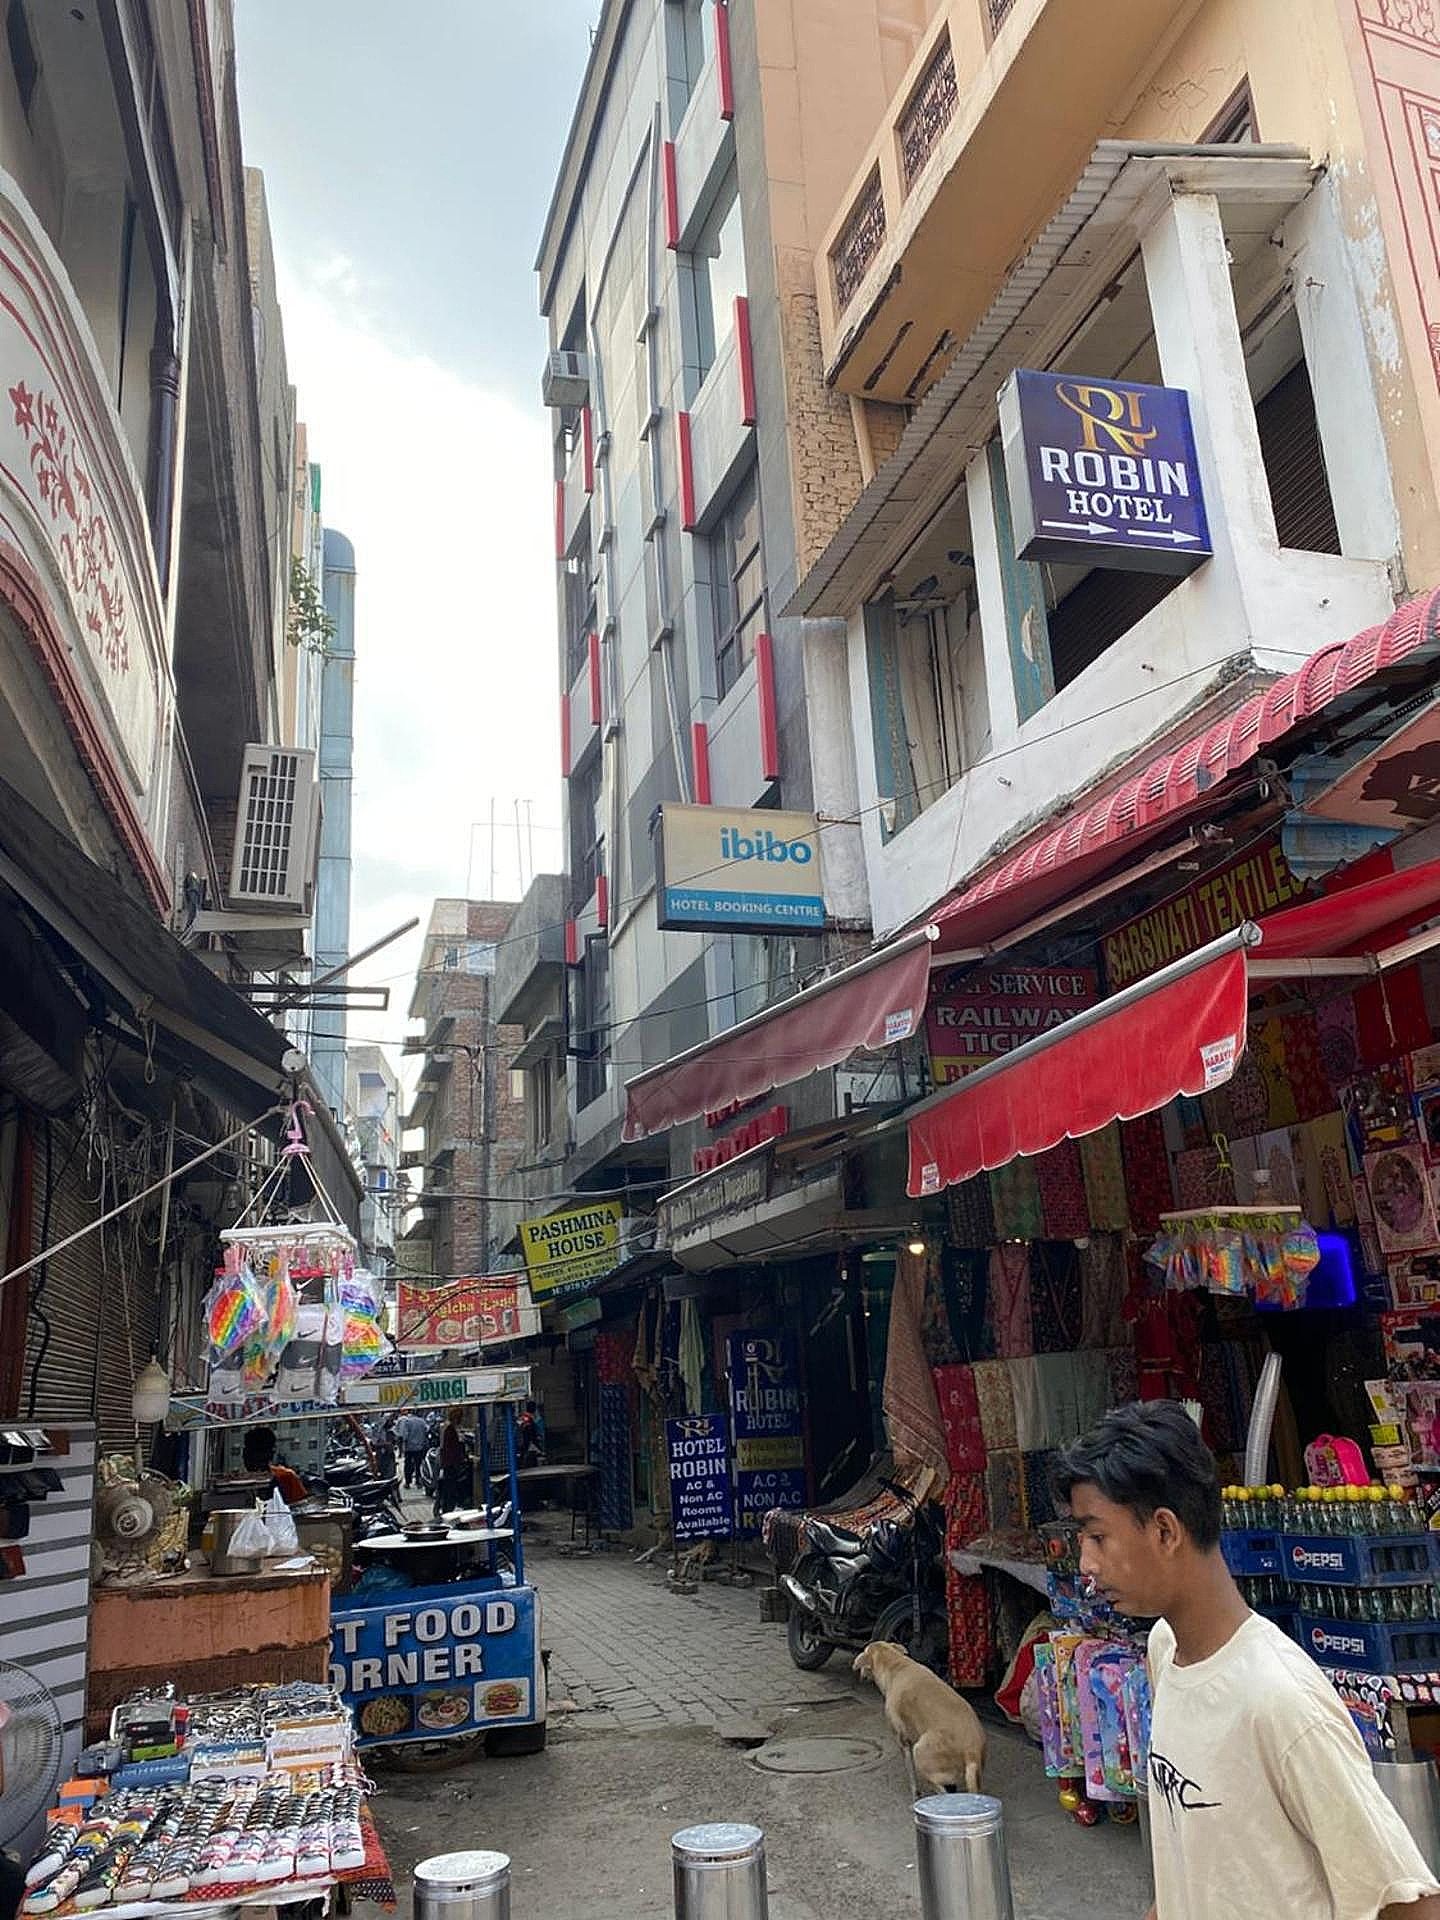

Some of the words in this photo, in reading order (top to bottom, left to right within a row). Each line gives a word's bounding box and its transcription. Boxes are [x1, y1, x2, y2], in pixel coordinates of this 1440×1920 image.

[1039, 446, 1190, 497] ROBIN
[1066, 489, 1173, 523] HOTEL
[719, 826, 813, 865] ibibo
[671, 899, 711, 912] HOTEL
[714, 901, 772, 915] BOOKING
[774, 904, 821, 917] CENTRE
[1107, 892, 1200, 984] SARSWATI
[989, 973, 1086, 996] SERVICE
[528, 1208, 617, 1243] PASHMINA
[548, 1231, 607, 1259] HOUSE
[420, 1377, 467, 1402] BURG
[746, 1414, 790, 1430] HOTEL
[671, 1438, 726, 1458] HOTEL
[670, 1458, 727, 1480] ROBIN
[686, 1480, 703, 1490] AC
[706, 1480, 715, 1489] &
[680, 1493, 703, 1504] Non
[706, 1491, 723, 1501] AC
[744, 1493, 774, 1508] NON
[682, 1506, 723, 1516] Rooms
[676, 1515, 730, 1530] Available
[1304, 1552, 1344, 1568] PEPSI
[384, 1601, 516, 1648] FOOD
[1324, 1637, 1365, 1654] PEPSI
